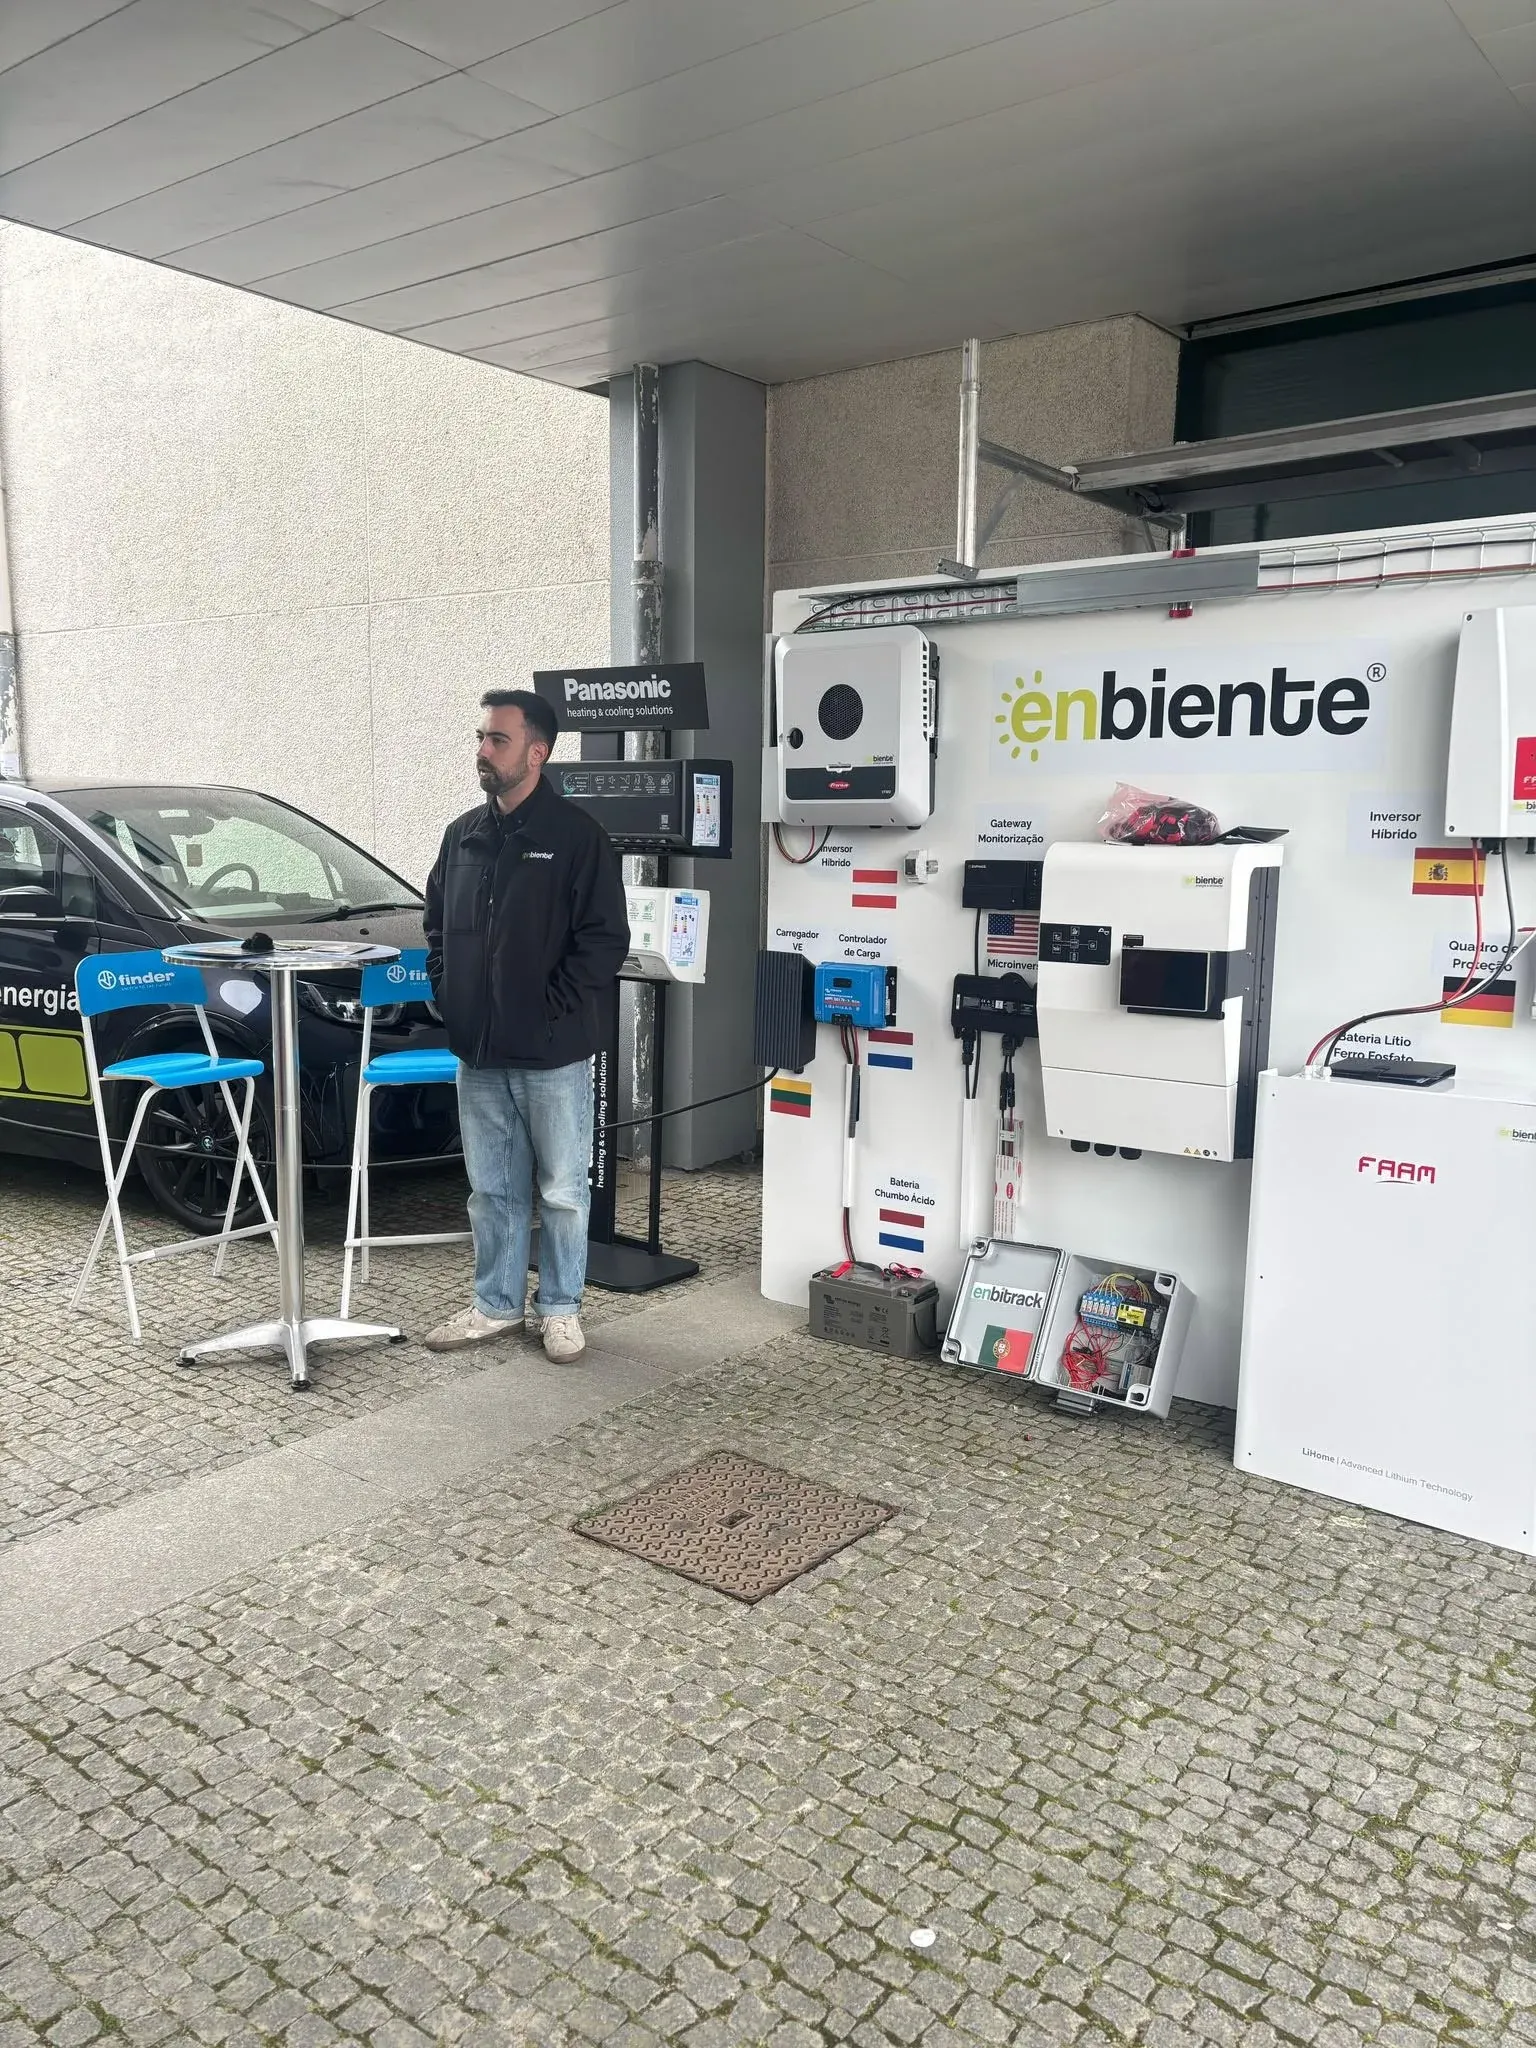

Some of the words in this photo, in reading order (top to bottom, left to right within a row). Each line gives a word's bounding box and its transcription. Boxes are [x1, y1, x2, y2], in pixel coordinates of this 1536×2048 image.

[563, 674, 671, 701] Panasonic
[566, 707, 597, 719] heating
[605, 705, 634, 718] cooling
[635, 704, 673, 716] solutions
[1369, 812, 1422, 822] Inversor
[990, 819, 1032, 830] Gateway
[978, 834, 1044, 845] Monitorização
[1371, 829, 1418, 840] Híbrido
[776, 928, 819, 939] Carregador
[838, 934, 887, 945] Controlador
[792, 943, 803, 951] VE
[844, 948, 855, 957] de
[857, 949, 880, 959] Carga
[118, 971, 175, 986] finder
[0, 984, 79, 1016] nergia
[1384, 1035, 1412, 1047] Lítio
[1333, 1048, 1365, 1059] Ferro
[599, 1051, 608, 1098] solutions
[598, 1139, 605, 1147] &
[596, 1149, 607, 1188] heating
[1358, 1156, 1436, 1184] FAAM
[890, 1177, 920, 1189] Bateria
[874, 1188, 910, 1202] Chumbo
[911, 1192, 936, 1206] Ácido
[973, 1285, 1043, 1309] enbitrack
[1302, 1447, 1336, 1463] LiHome
[1340, 1458, 1384, 1476] Advanced
[1385, 1470, 1418, 1486] Lithium
[1420, 1479, 1474, 1502] Technology
